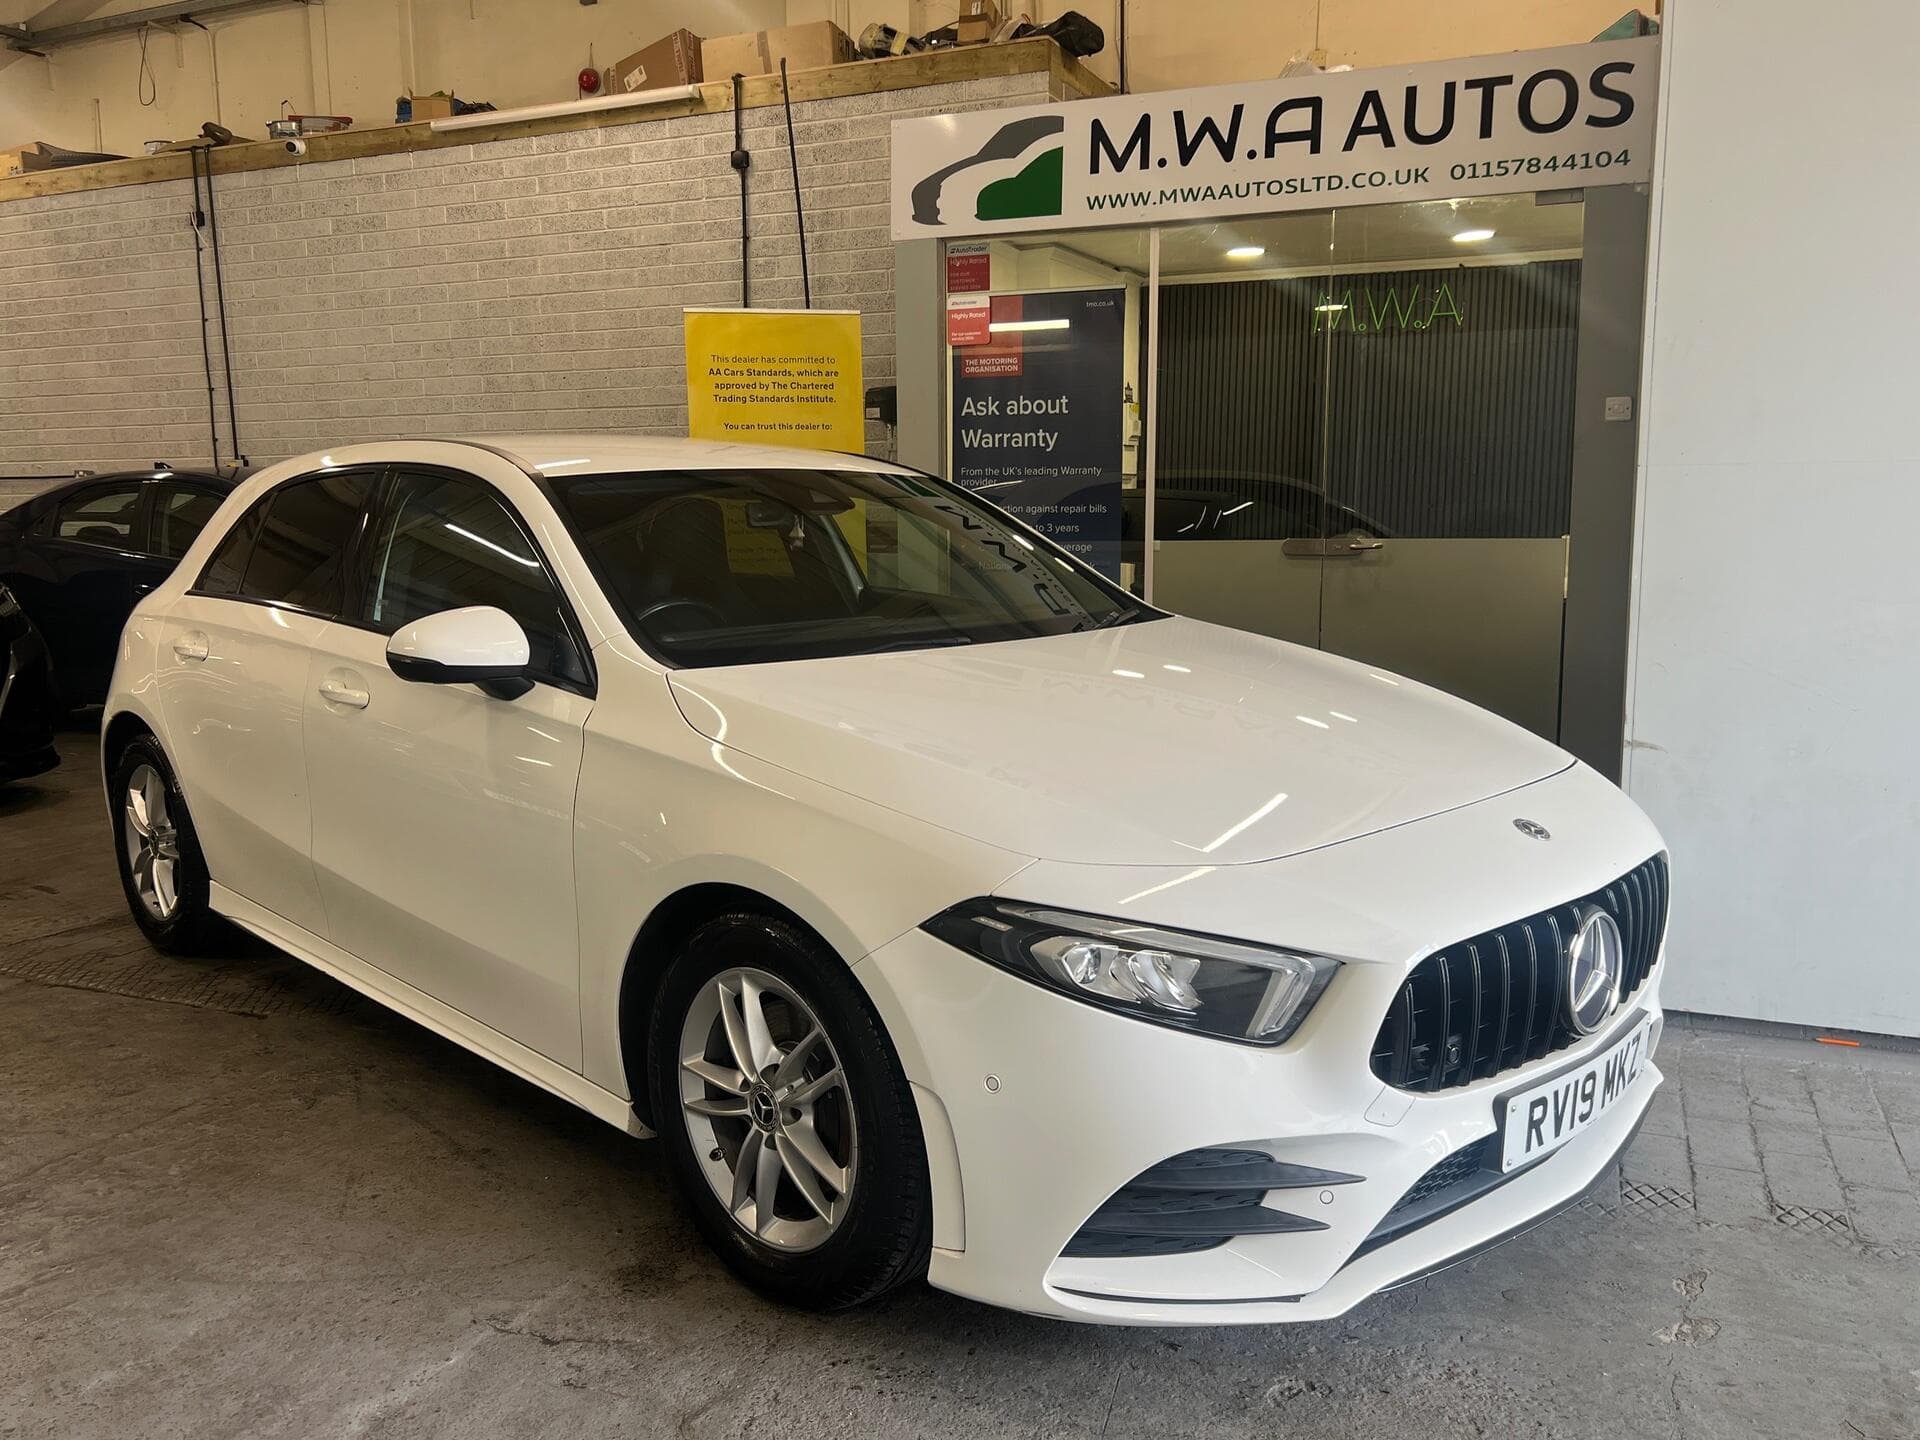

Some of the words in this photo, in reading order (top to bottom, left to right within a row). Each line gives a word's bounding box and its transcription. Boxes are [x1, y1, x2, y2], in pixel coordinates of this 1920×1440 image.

[1090, 96, 1323, 174] M.W.A
[1342, 62, 1635, 152] AUTOS
[1087, 167, 1430, 211] WWW.MWAAUTOSLTD.CO.UK
[1450, 149, 1631, 181] 01157844104
[711, 354, 729, 363] This
[732, 355, 758, 363] dealer
[761, 356, 776, 364] has
[779, 356, 825, 364] committed
[965, 358, 979, 366] THE
[980, 357, 1018, 366] MOTORING
[708, 368, 721, 376] AA
[724, 368, 744, 377] Cars
[746, 369, 795, 378] Standards,
[797, 369, 822, 377] which
[965, 365, 1019, 373] ORGANISATION
[714, 382, 757, 391] approved
[759, 382, 769, 391] by
[771, 382, 787, 390] The
[790, 382, 834, 390] Chartered
[713, 394, 747, 404] Trading
[749, 395, 794, 403] Standards
[797, 395, 837, 403] Institute.
[961, 396, 1000, 416] Ask
[1006, 395, 1069, 416] about
[961, 428, 1058, 452] Warranty
[961, 467, 983, 476] From
[985, 467, 999, 476] the
[1002, 466, 1022, 476] UK's
[1025, 466, 1058, 477] leading
[1061, 465, 1102, 477] Warranty
[961, 477, 998, 486] provider
[1001, 504, 1023, 513] ction
[1026, 504, 1058, 515] against
[1061, 503, 1087, 514] repair
[1089, 503, 1107, 513] bills
[1035, 524, 1044, 532] to
[1047, 523, 1053, 531] 3
[1055, 524, 1080, 533] years
[1525, 1070, 1598, 1153] RV19
[1600, 1029, 1642, 1110] MKZ
